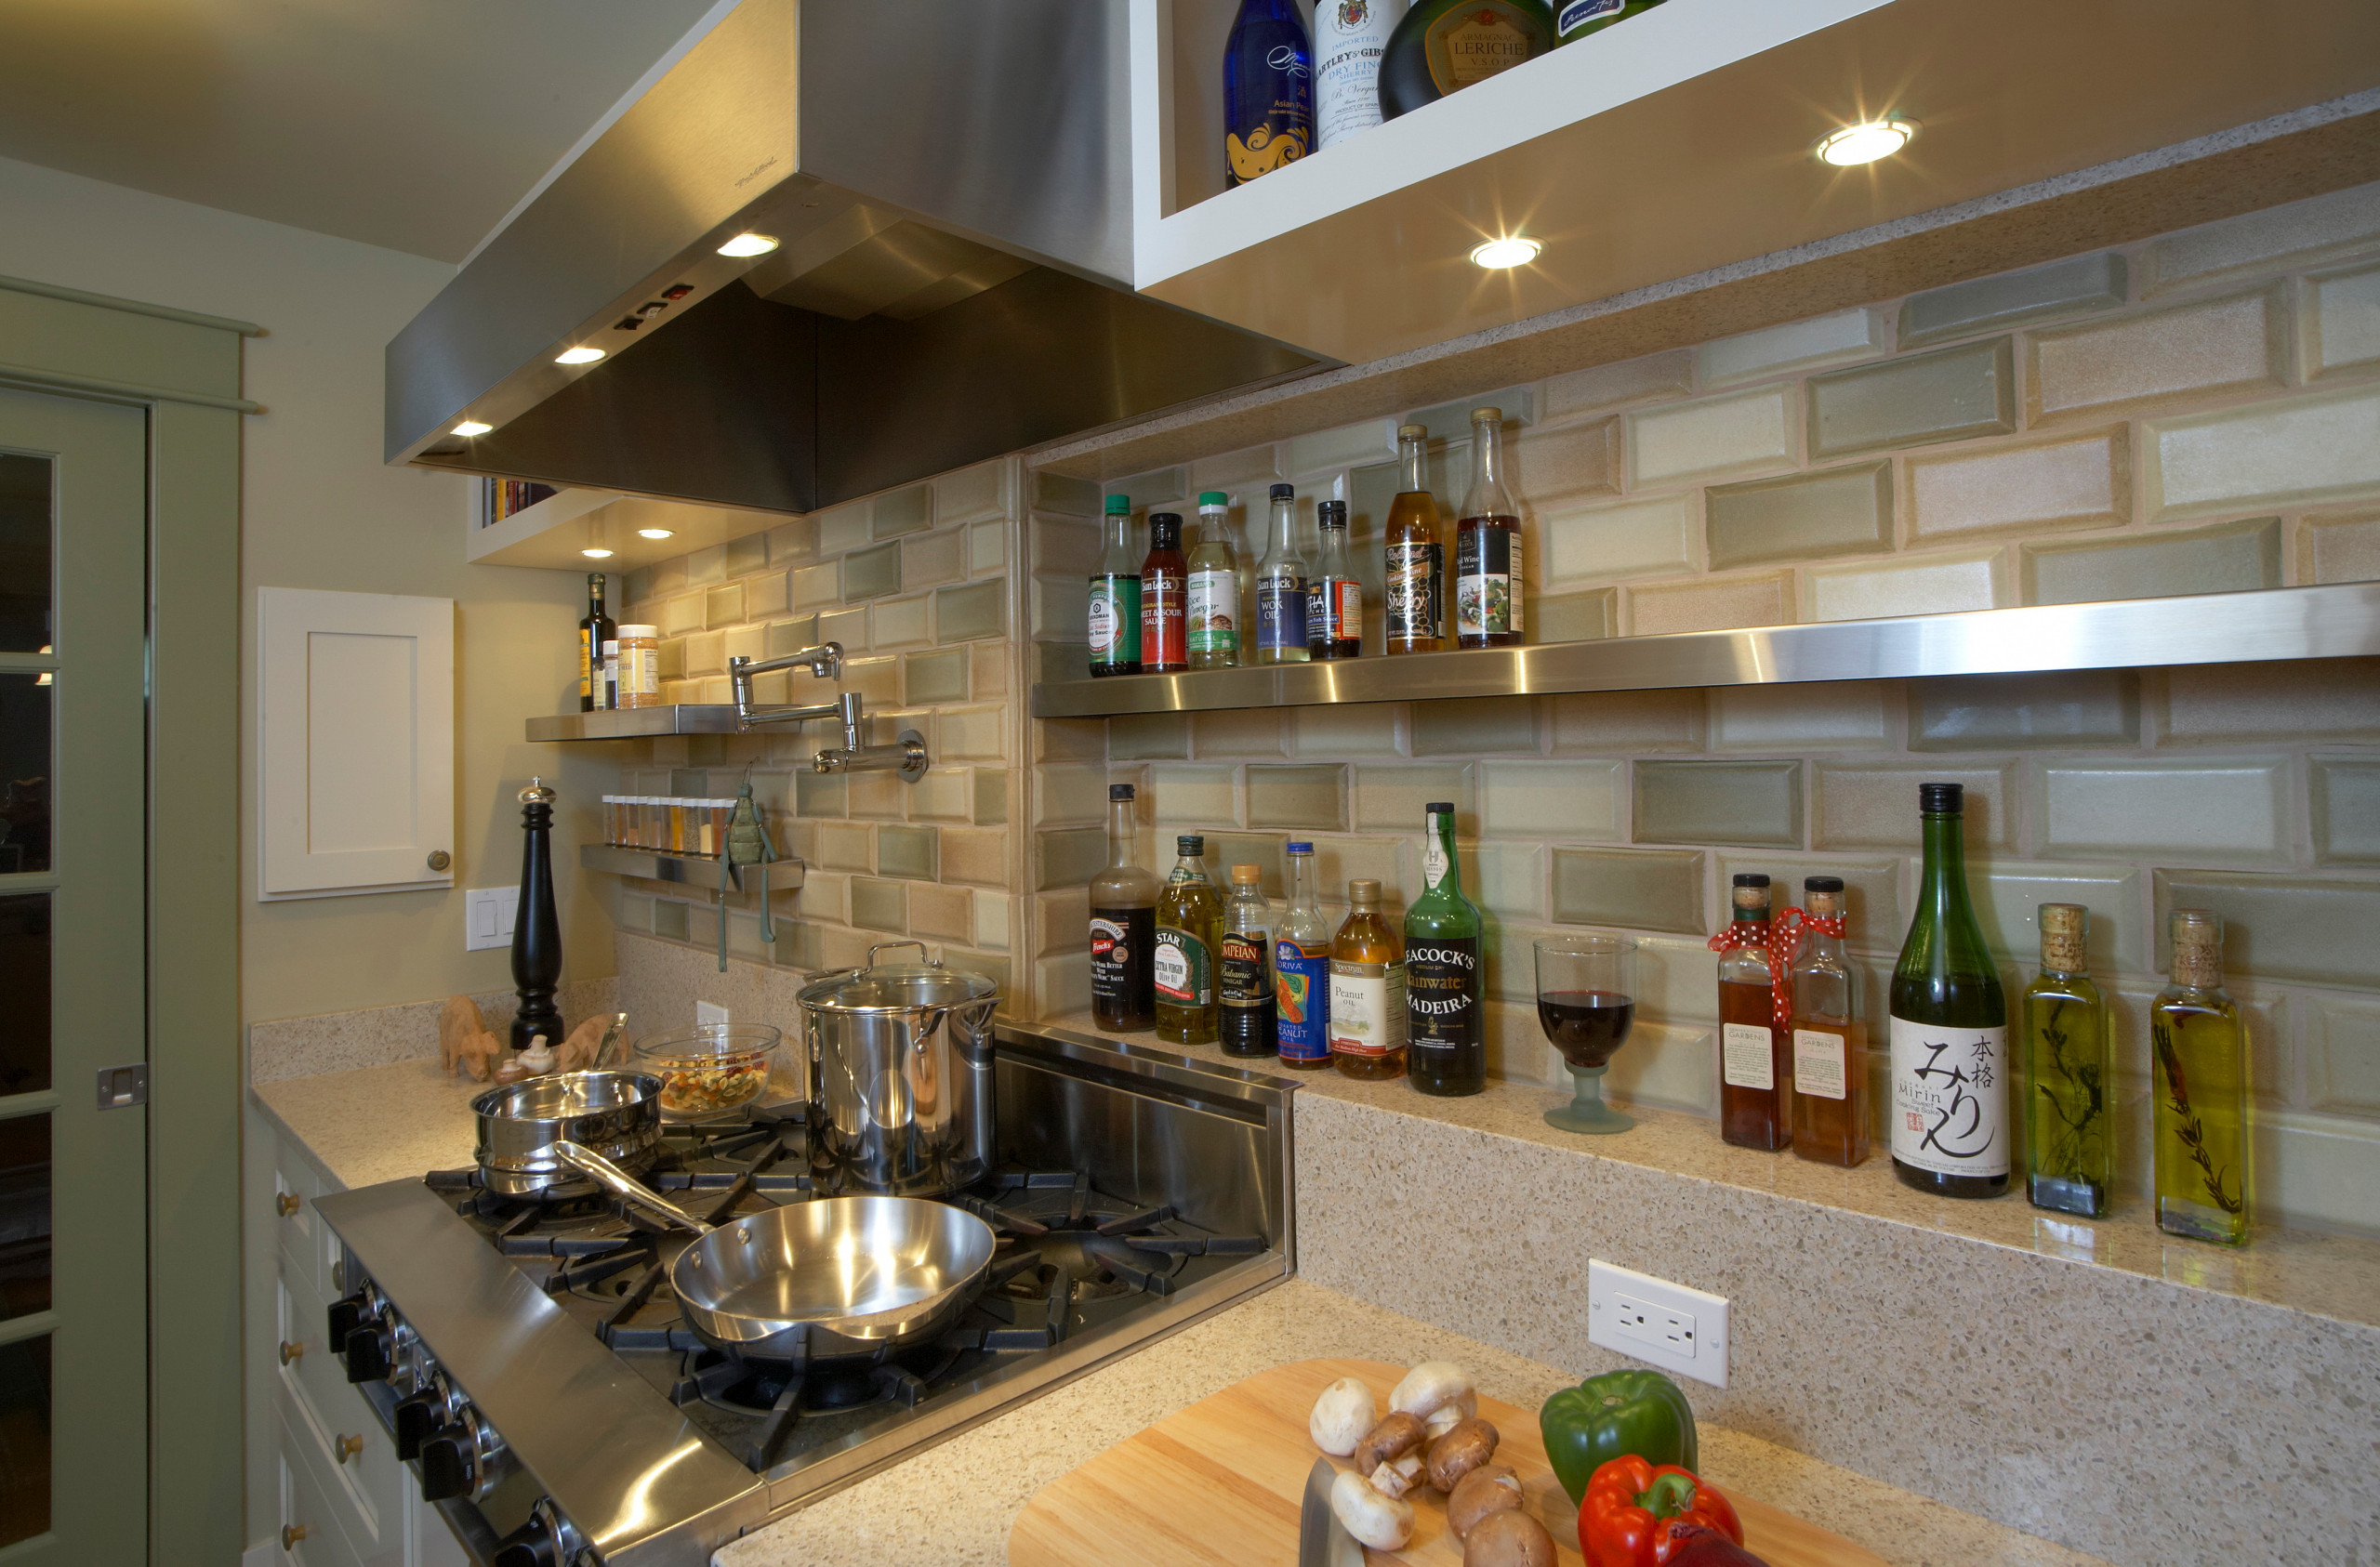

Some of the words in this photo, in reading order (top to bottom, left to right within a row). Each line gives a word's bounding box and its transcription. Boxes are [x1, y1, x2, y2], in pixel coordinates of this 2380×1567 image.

[1332, 35, 1379, 51] IMPORTED
[1454, 42, 1525, 56] LERICHE
[1316, 50, 1352, 81] ARTLEY
[1329, 64, 1351, 81] DRY
[1339, 69, 1373, 80] SHERRY
[1274, 99, 1295, 109] Asian
[1142, 581, 1152, 592] Sun
[1153, 580, 1172, 590] Luck
[1257, 581, 1269, 590] Sun
[1270, 578, 1290, 589] Luck
[1262, 601, 1284, 611] WOK
[1387, 591, 1425, 610] Sherry
[1161, 609, 1183, 617] SOUR
[1264, 611, 1280, 620] OIL
[1144, 617, 1167, 625] SAUCE
[1156, 932, 1181, 947] STAR
[1092, 942, 1111, 952] French's
[1168, 963, 1183, 975] VIRGIN
[1335, 963, 1362, 973] Spectrum
[1158, 971, 1170, 981] Olive
[1335, 986, 1364, 1000] Peanut
[1406, 989, 1473, 1015] MADEIRA
[1728, 1031, 1765, 1042] GARDENS
[1801, 1038, 1835, 1049] GARDENS
[1970, 1034, 1994, 1089] 本格
[1898, 1083, 1942, 1104] Mirin
[1911, 1098, 1935, 1109] Sweet
[1921, 1107, 1941, 1116] Sake
